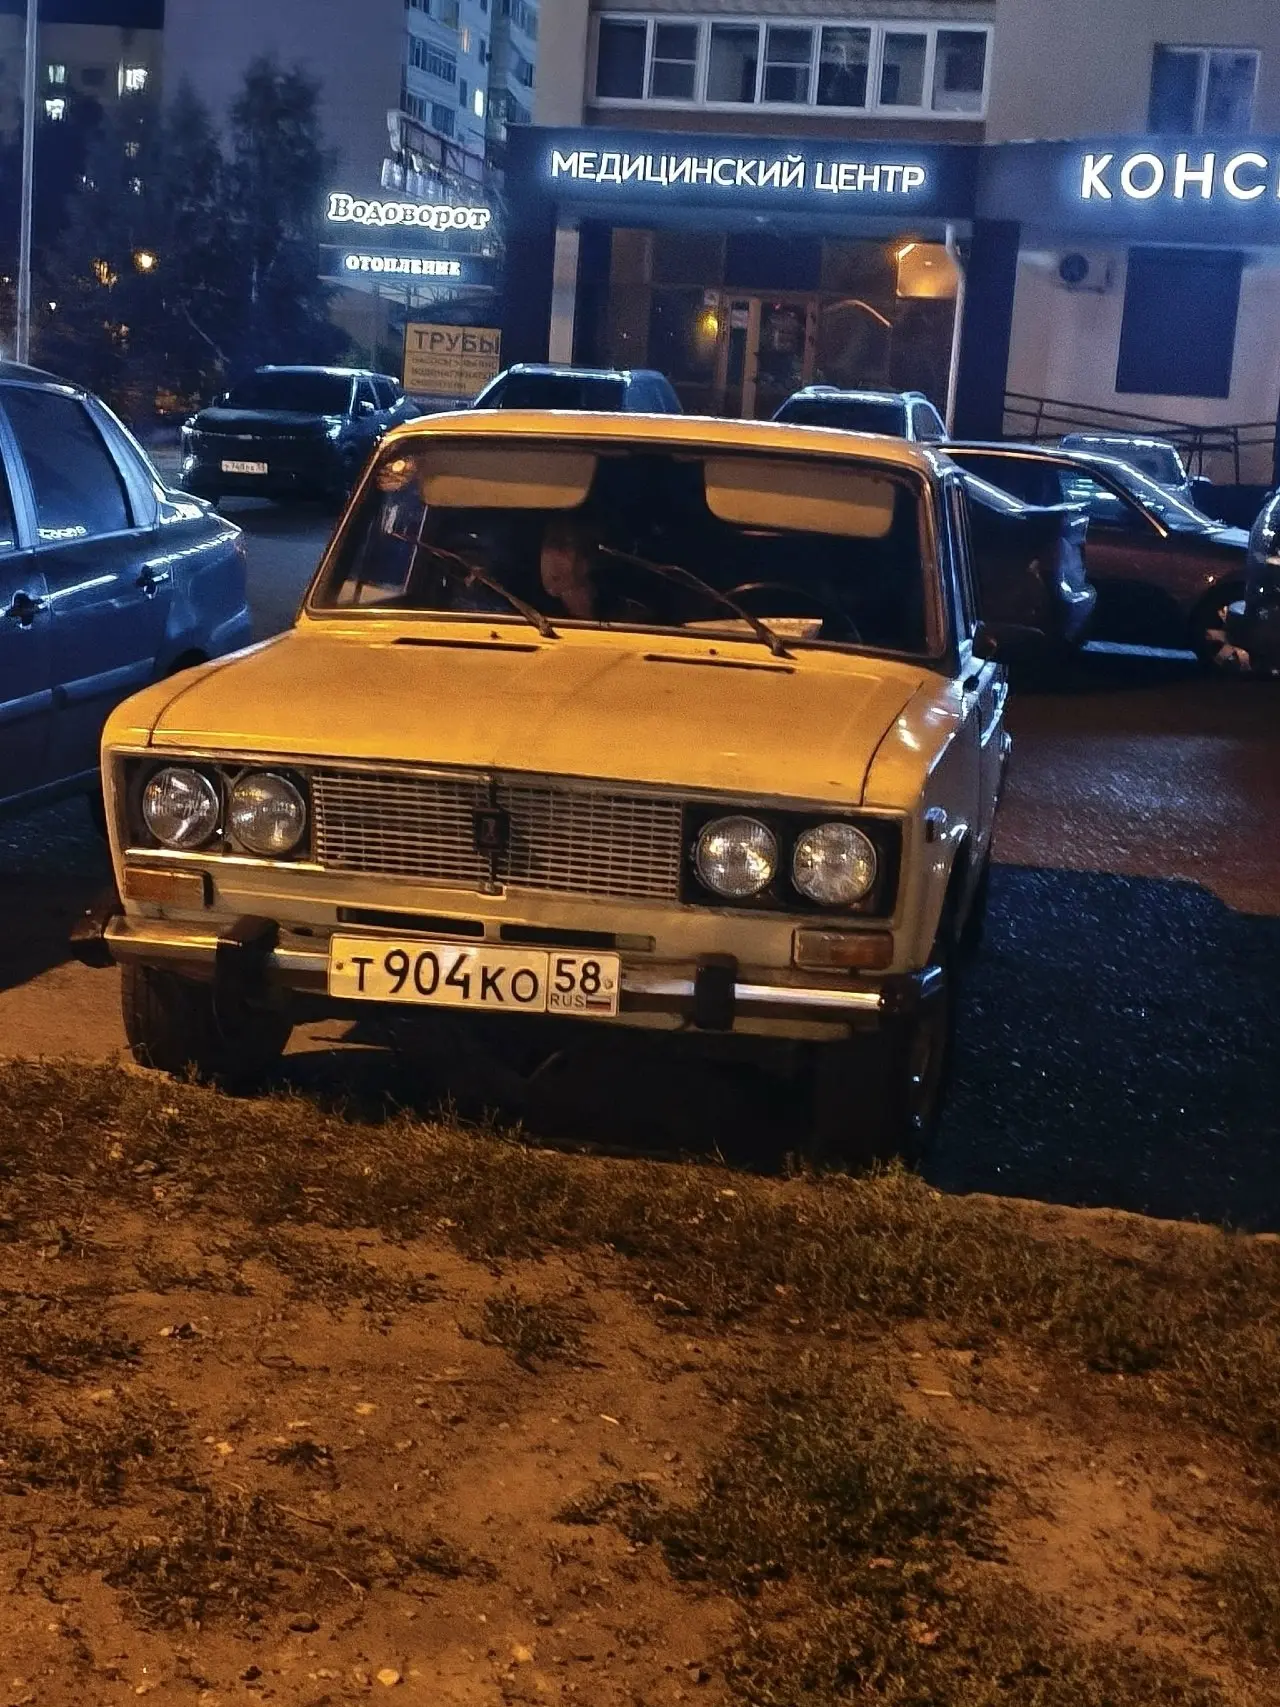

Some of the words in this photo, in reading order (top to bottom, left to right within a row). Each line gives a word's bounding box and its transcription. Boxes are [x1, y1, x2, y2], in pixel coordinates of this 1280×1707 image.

[551, 150, 804, 189] МЕДИЦИНСКИЙ
[814, 161, 925, 193] ЦЕНТР
[1081, 152, 1280, 200] КОНС
[413, 329, 499, 354] ТРУБЫ
[554, 958, 601, 995] 58
[550, 992, 585, 1008] RUS
